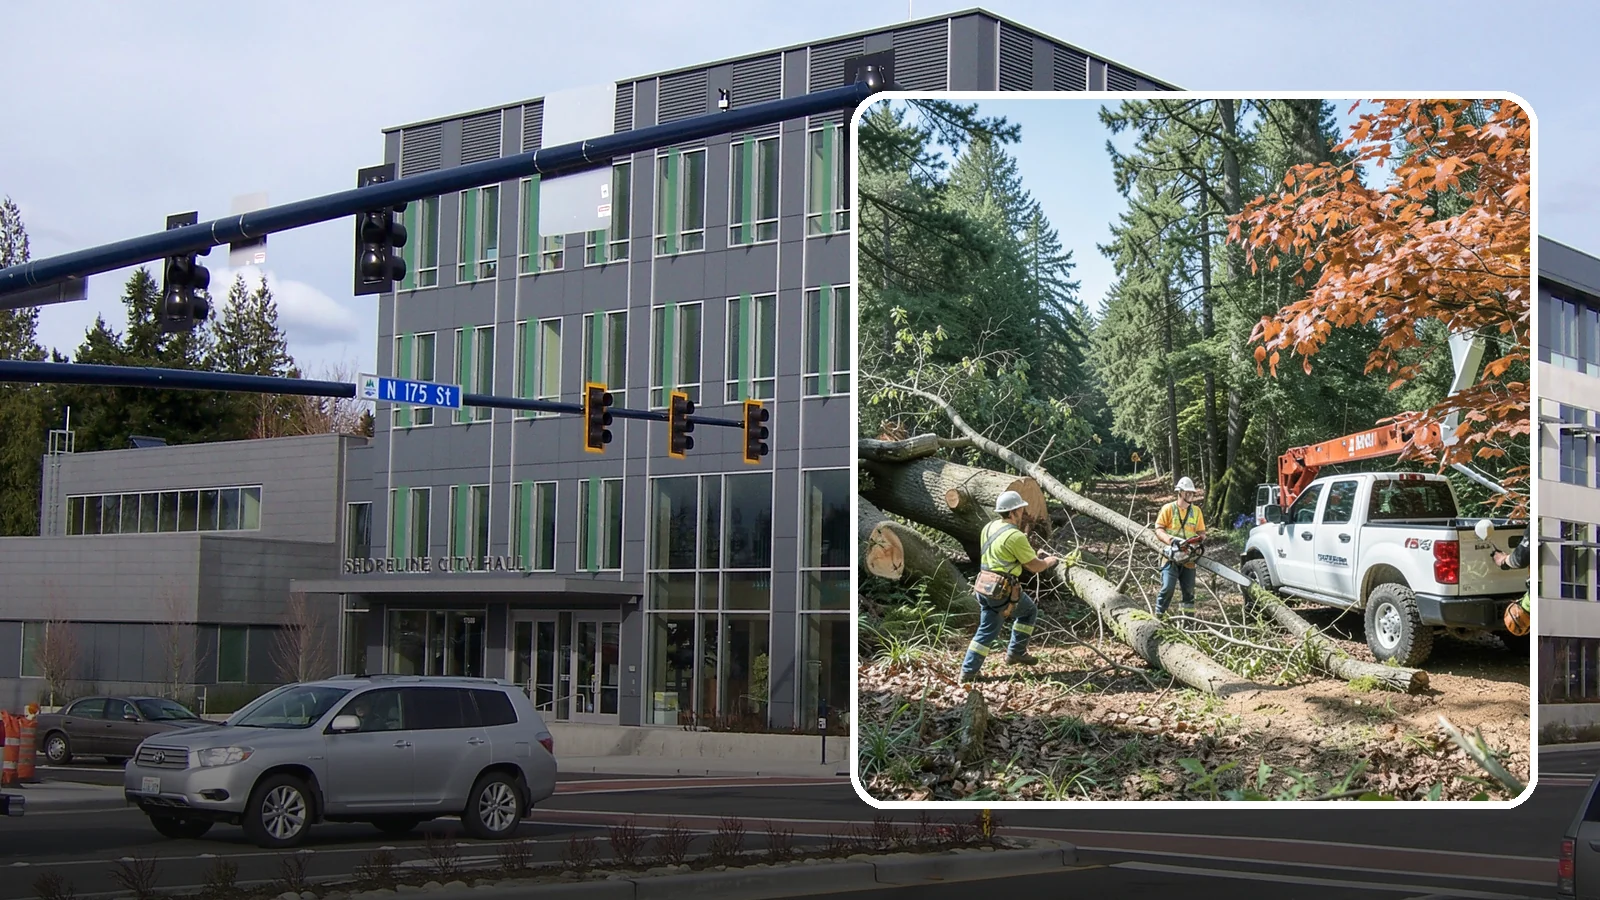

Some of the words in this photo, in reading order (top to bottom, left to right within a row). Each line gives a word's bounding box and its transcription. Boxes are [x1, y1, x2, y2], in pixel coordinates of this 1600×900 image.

[387, 380, 396, 400] N
[405, 382, 428, 403] 175
[436, 386, 451, 406] St
[343, 557, 433, 574] SHORELINE
[438, 556, 475, 572] CITY
[483, 556, 525, 572] HALL
